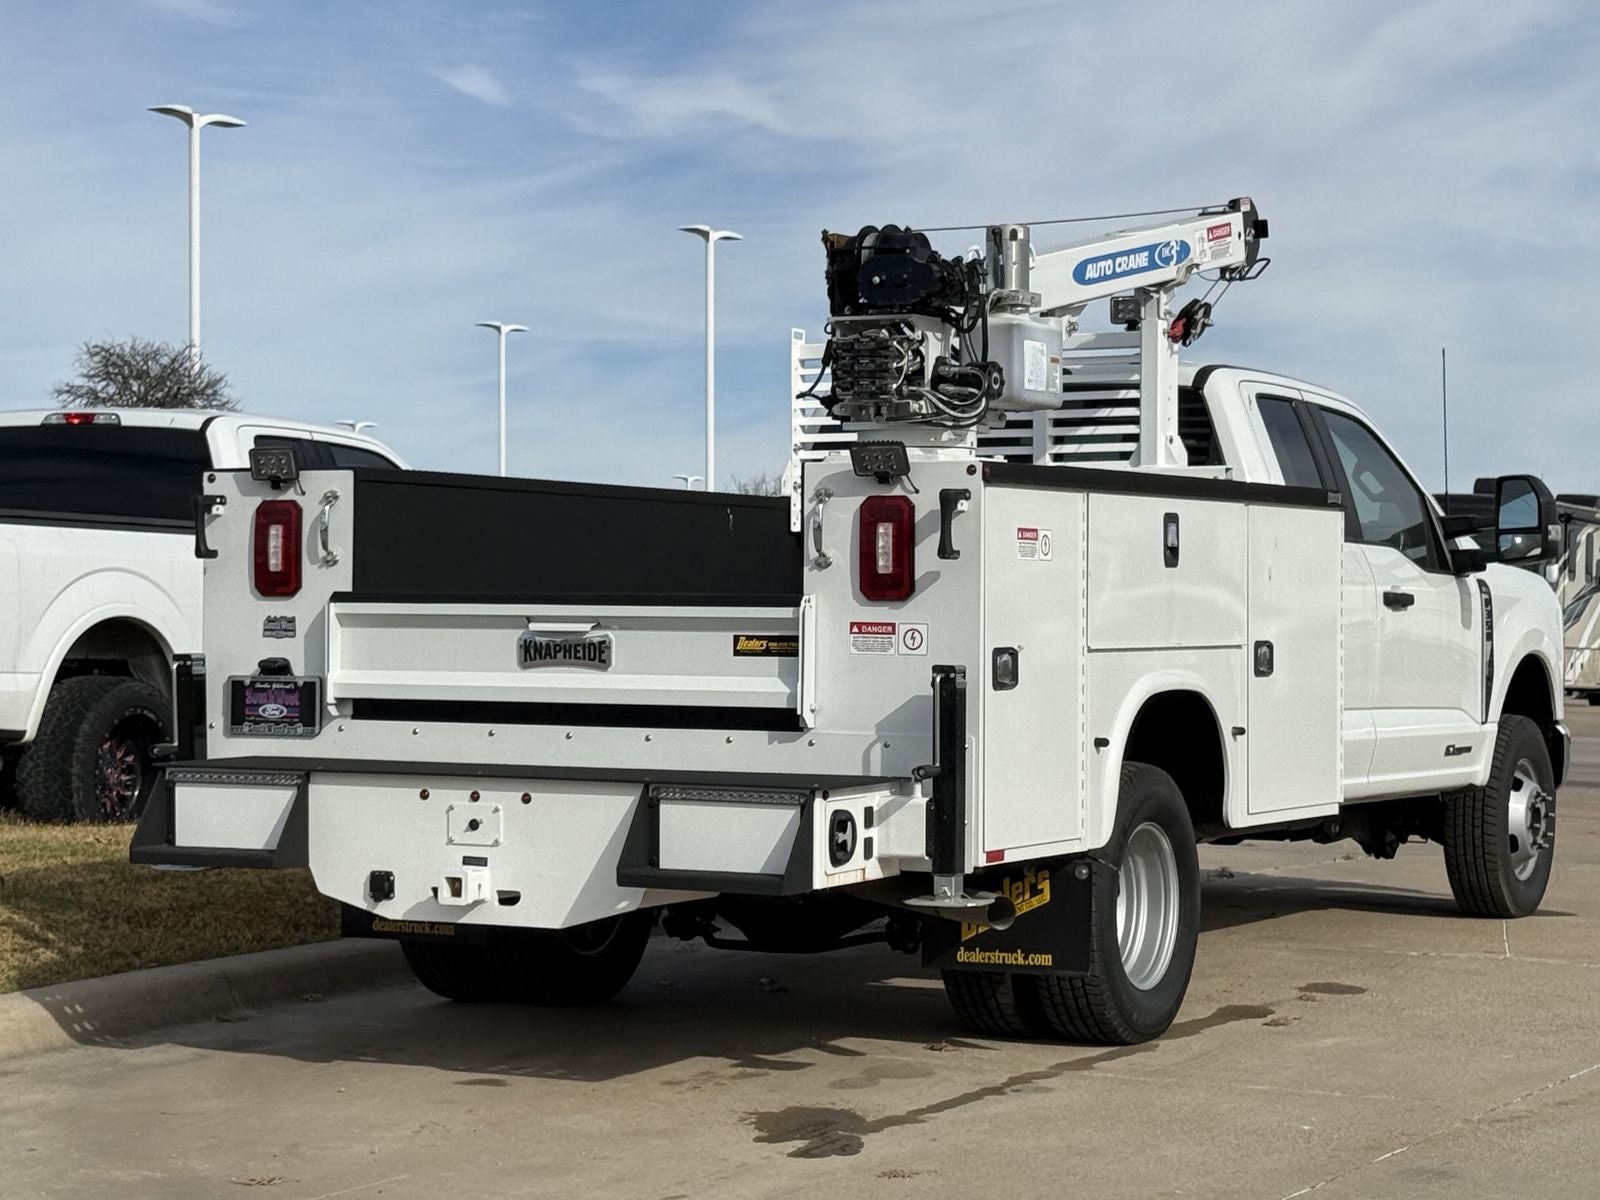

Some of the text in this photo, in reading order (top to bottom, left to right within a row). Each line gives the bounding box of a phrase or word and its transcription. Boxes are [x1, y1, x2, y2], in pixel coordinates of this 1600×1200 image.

[1085, 261, 1113, 281] AUTO
[1115, 251, 1150, 273] CRANE
[861, 625, 893, 633] DANGER
[523, 639, 608, 664] KNAPHEIDE
[956, 947, 1053, 966] dealerstruck.com
